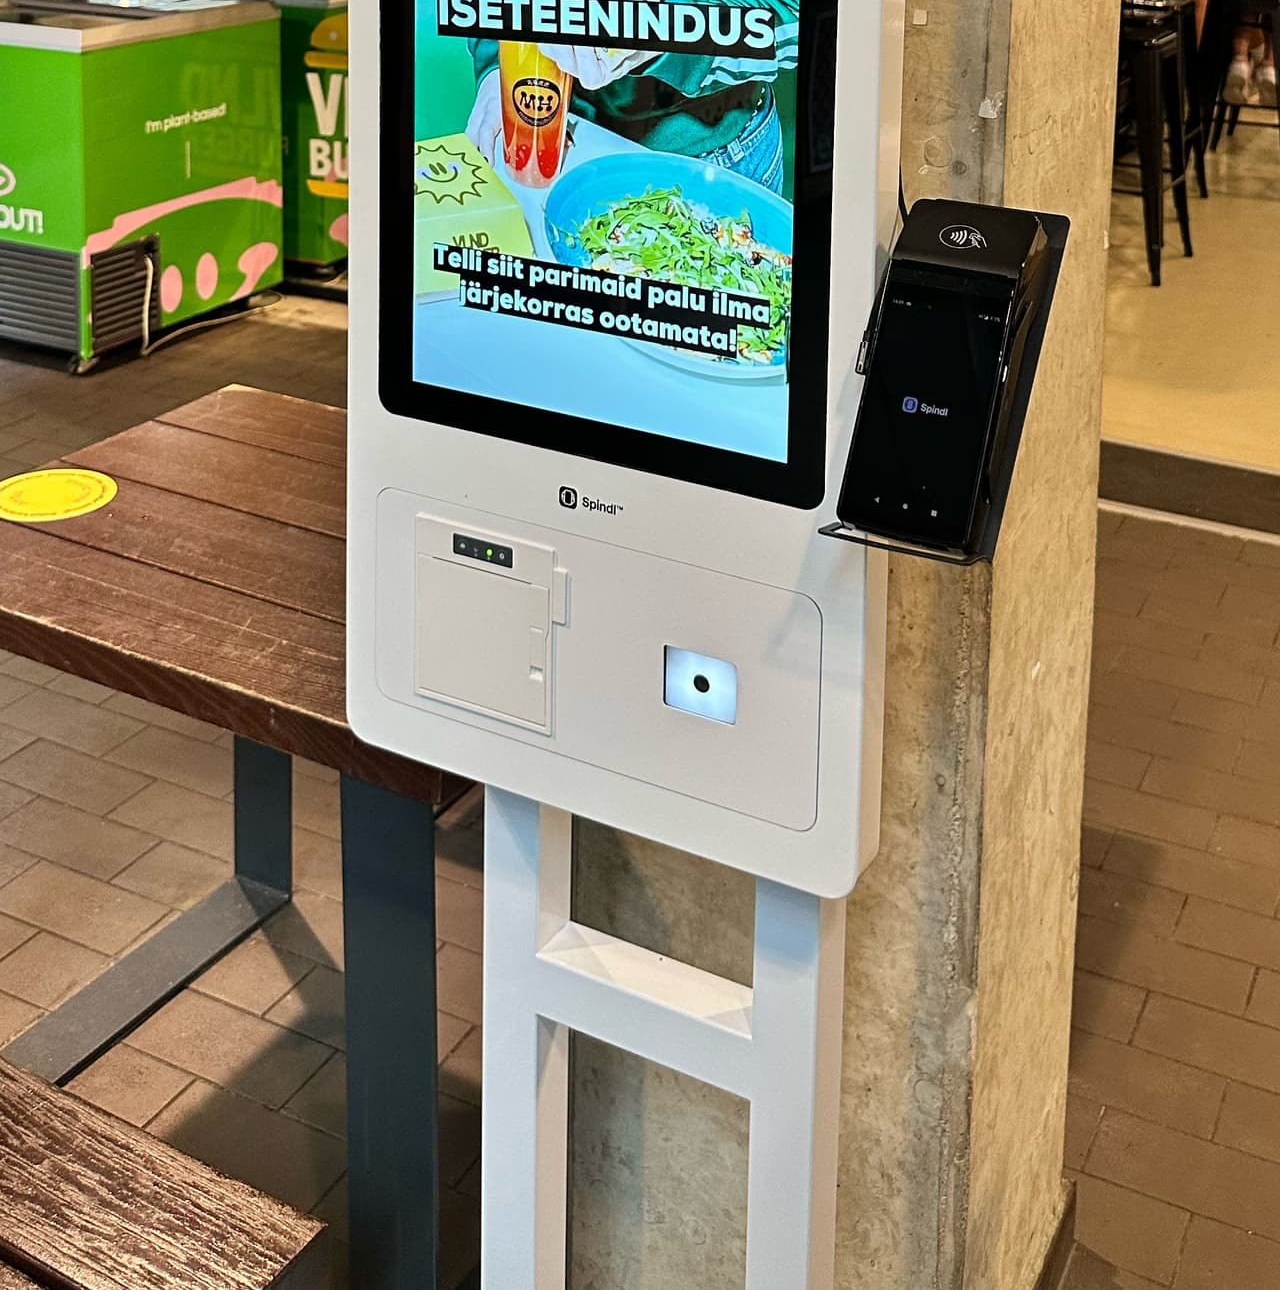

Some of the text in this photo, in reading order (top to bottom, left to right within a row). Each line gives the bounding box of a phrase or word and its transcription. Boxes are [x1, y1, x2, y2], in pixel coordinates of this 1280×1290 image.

[164, 102, 227, 132] plant-based
[433, 243, 770, 324] Telli siit parimaid palu ilma
[460, 279, 737, 352] järjekorras ootamata!
[920, 403, 949, 416] Spindl
